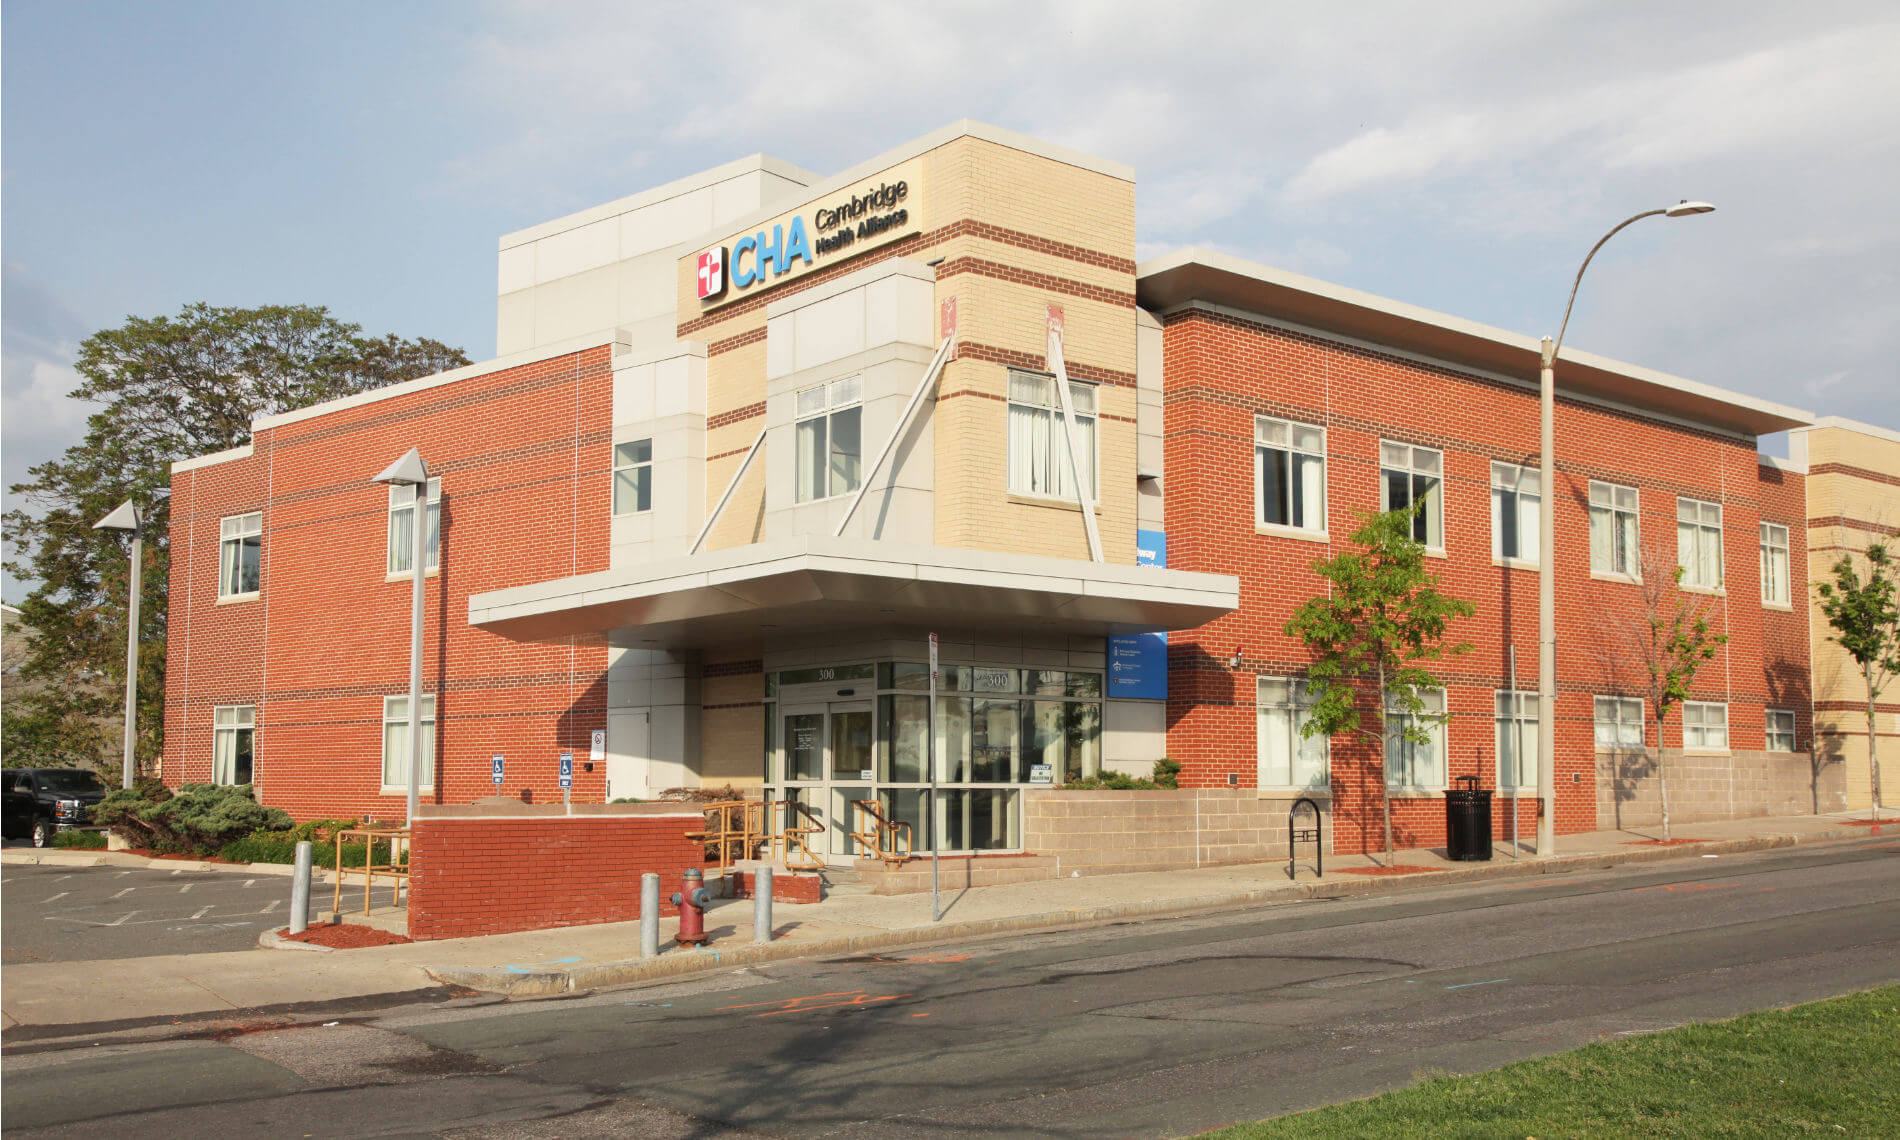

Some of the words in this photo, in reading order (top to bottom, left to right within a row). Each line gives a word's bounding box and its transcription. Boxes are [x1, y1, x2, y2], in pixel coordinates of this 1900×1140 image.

[815, 180, 908, 230] Cambridge
[730, 215, 813, 287] CHA
[815, 226, 855, 254] Health
[857, 209, 908, 239] Alliance
[819, 668, 835, 680] 300
[988, 674, 1008, 687] 300
